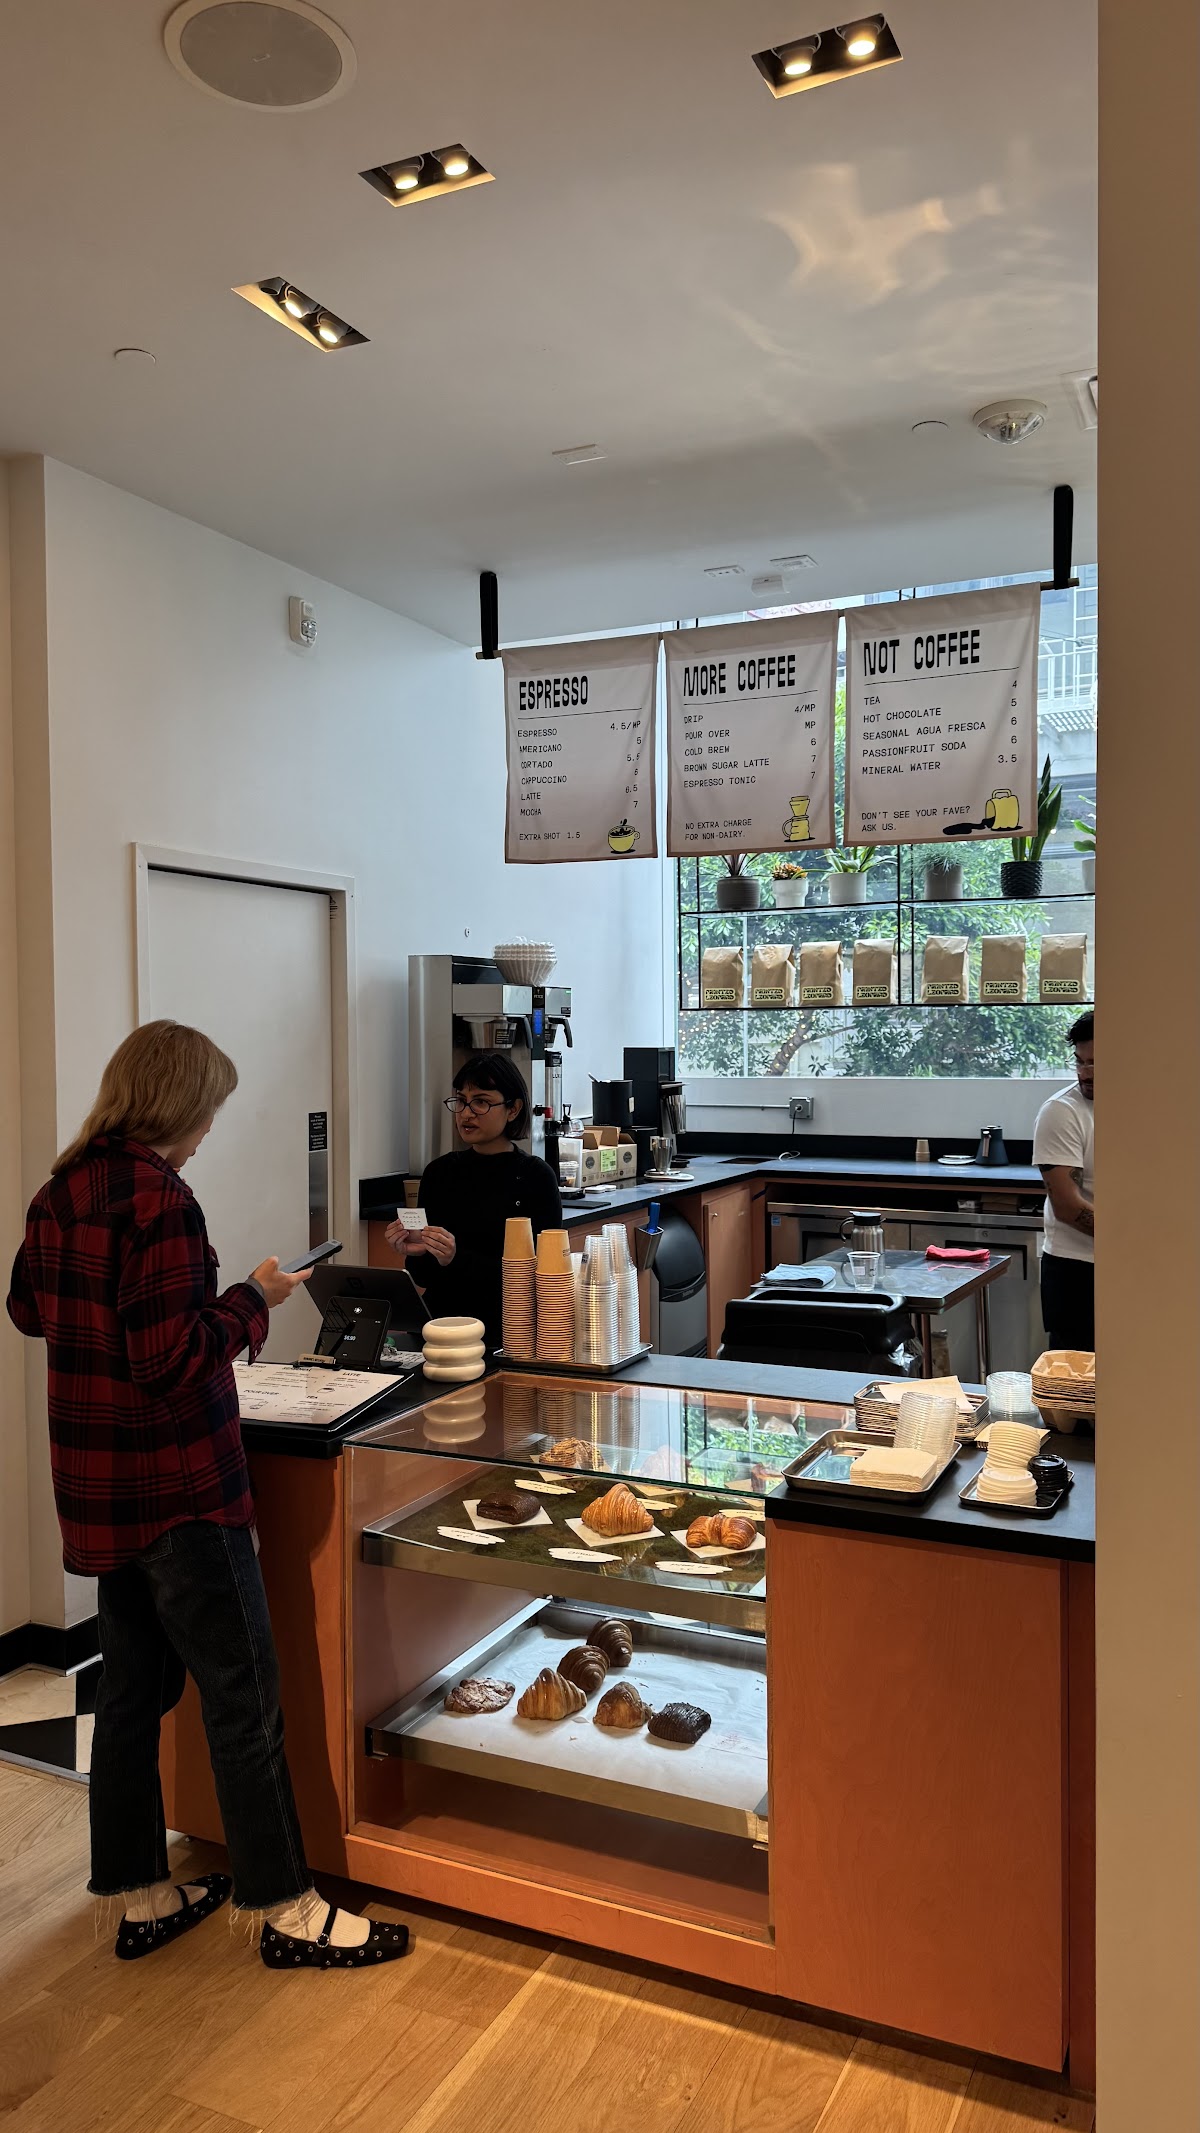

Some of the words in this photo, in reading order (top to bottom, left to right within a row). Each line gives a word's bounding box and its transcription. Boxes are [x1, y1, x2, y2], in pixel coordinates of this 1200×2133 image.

[864, 639, 899, 676] NOT
[914, 629, 980, 669] COFFEE
[684, 663, 726, 696] MORE
[738, 655, 795, 691] COFFEE
[519, 676, 588, 710] ESPRESSO
[864, 696, 880, 705] TEA
[684, 715, 703, 724] DRIP
[795, 704, 815, 713] 4/MP
[864, 714, 880, 723] HOT
[887, 708, 941, 720] CHOCOLATE
[1011, 698, 1017, 706] 5
[518, 729, 557, 737] ESPRESSO
[611, 721, 640, 730] 4.5/MP
[686, 731, 702, 739] POUR
[863, 729, 909, 740] SEASONAL
[917, 726, 941, 735] AGUA
[948, 722, 985, 732] FRESCA
[1011, 717, 1017, 725] 6
[520, 744, 561, 752] AMERICANO
[685, 748, 702, 756] COLD
[863, 744, 935, 757] PASSIONFRUIT
[941, 742, 966, 751] SODA
[521, 761, 552, 769] CORTADO
[712, 761, 738, 769] SUGAR
[744, 759, 769, 767] LATTE
[862, 765, 903, 774] MINERAL
[911, 762, 940, 771] WATER
[998, 754, 1017, 763] 3.5
[522, 776, 566, 784] CAPPUCCINO
[684, 778, 723, 788] ESPRESSO
[729, 776, 755, 784] TONIC
[862, 812, 888, 820] DON'T
[944, 806, 970, 814] FAVE?
[724, 819, 751, 827] CHARGE
[703, 831, 745, 839] NON-DAIRY.
